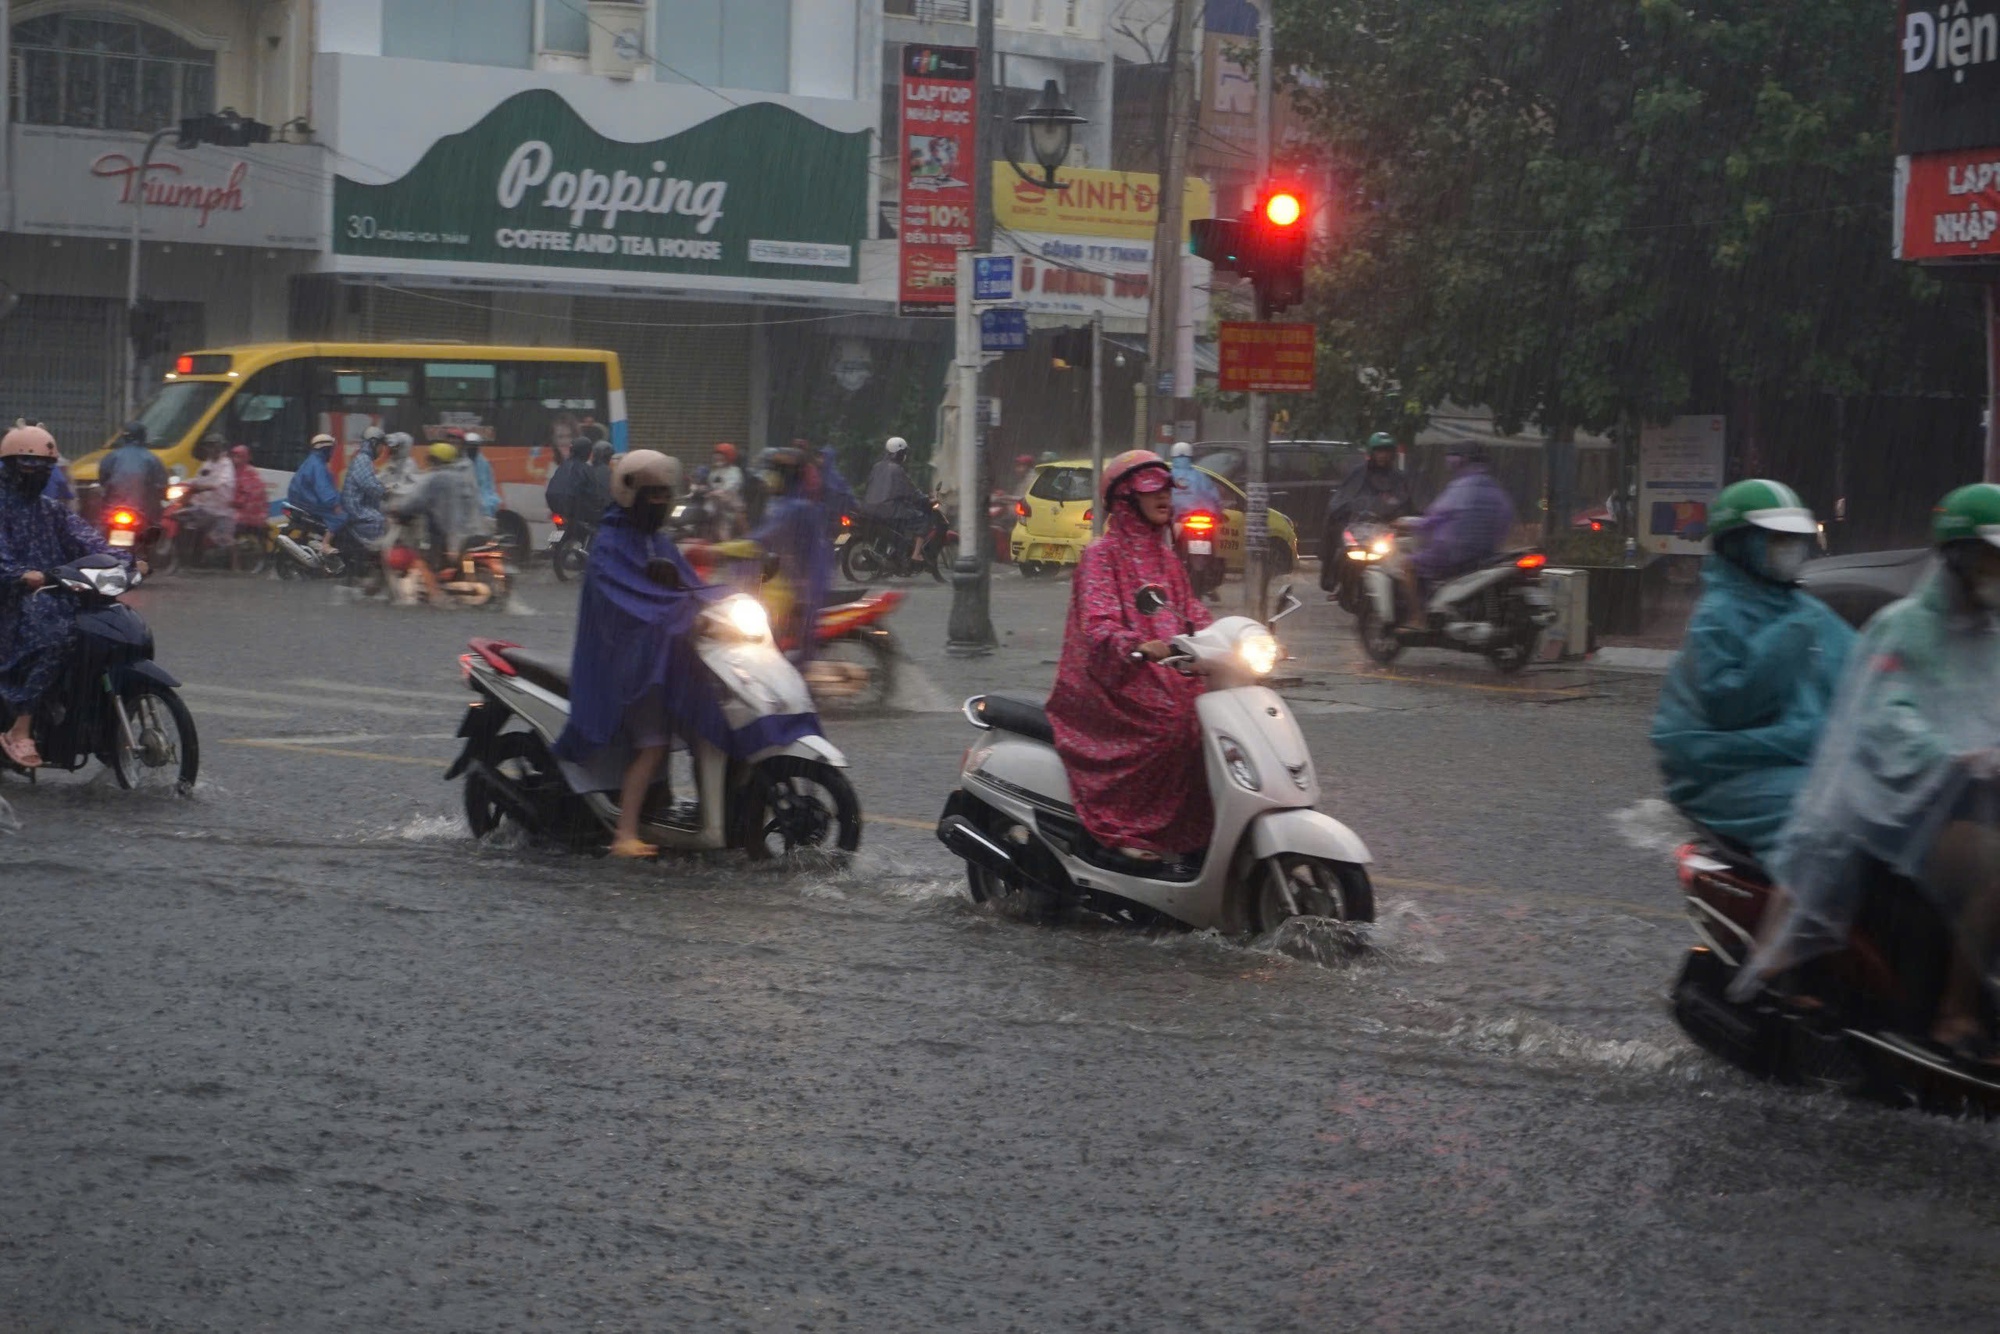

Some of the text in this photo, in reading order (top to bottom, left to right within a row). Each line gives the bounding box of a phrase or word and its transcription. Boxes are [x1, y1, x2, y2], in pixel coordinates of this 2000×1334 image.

[1902, 0, 1998, 84] Điện
[911, 49, 938, 73] FPT
[906, 83, 971, 104] LAPTOP
[906, 106, 941, 123] NHẬP
[91, 154, 248, 228] Triumph
[497, 140, 728, 234] Popping
[1058, 177, 1158, 212] KINH Đ
[347, 214, 377, 240] 30
[928, 205, 970, 228] 10%
[1934, 202, 1997, 249] NHẬP
[496, 228, 723, 261] COFFEE AND TEA HOUSE
